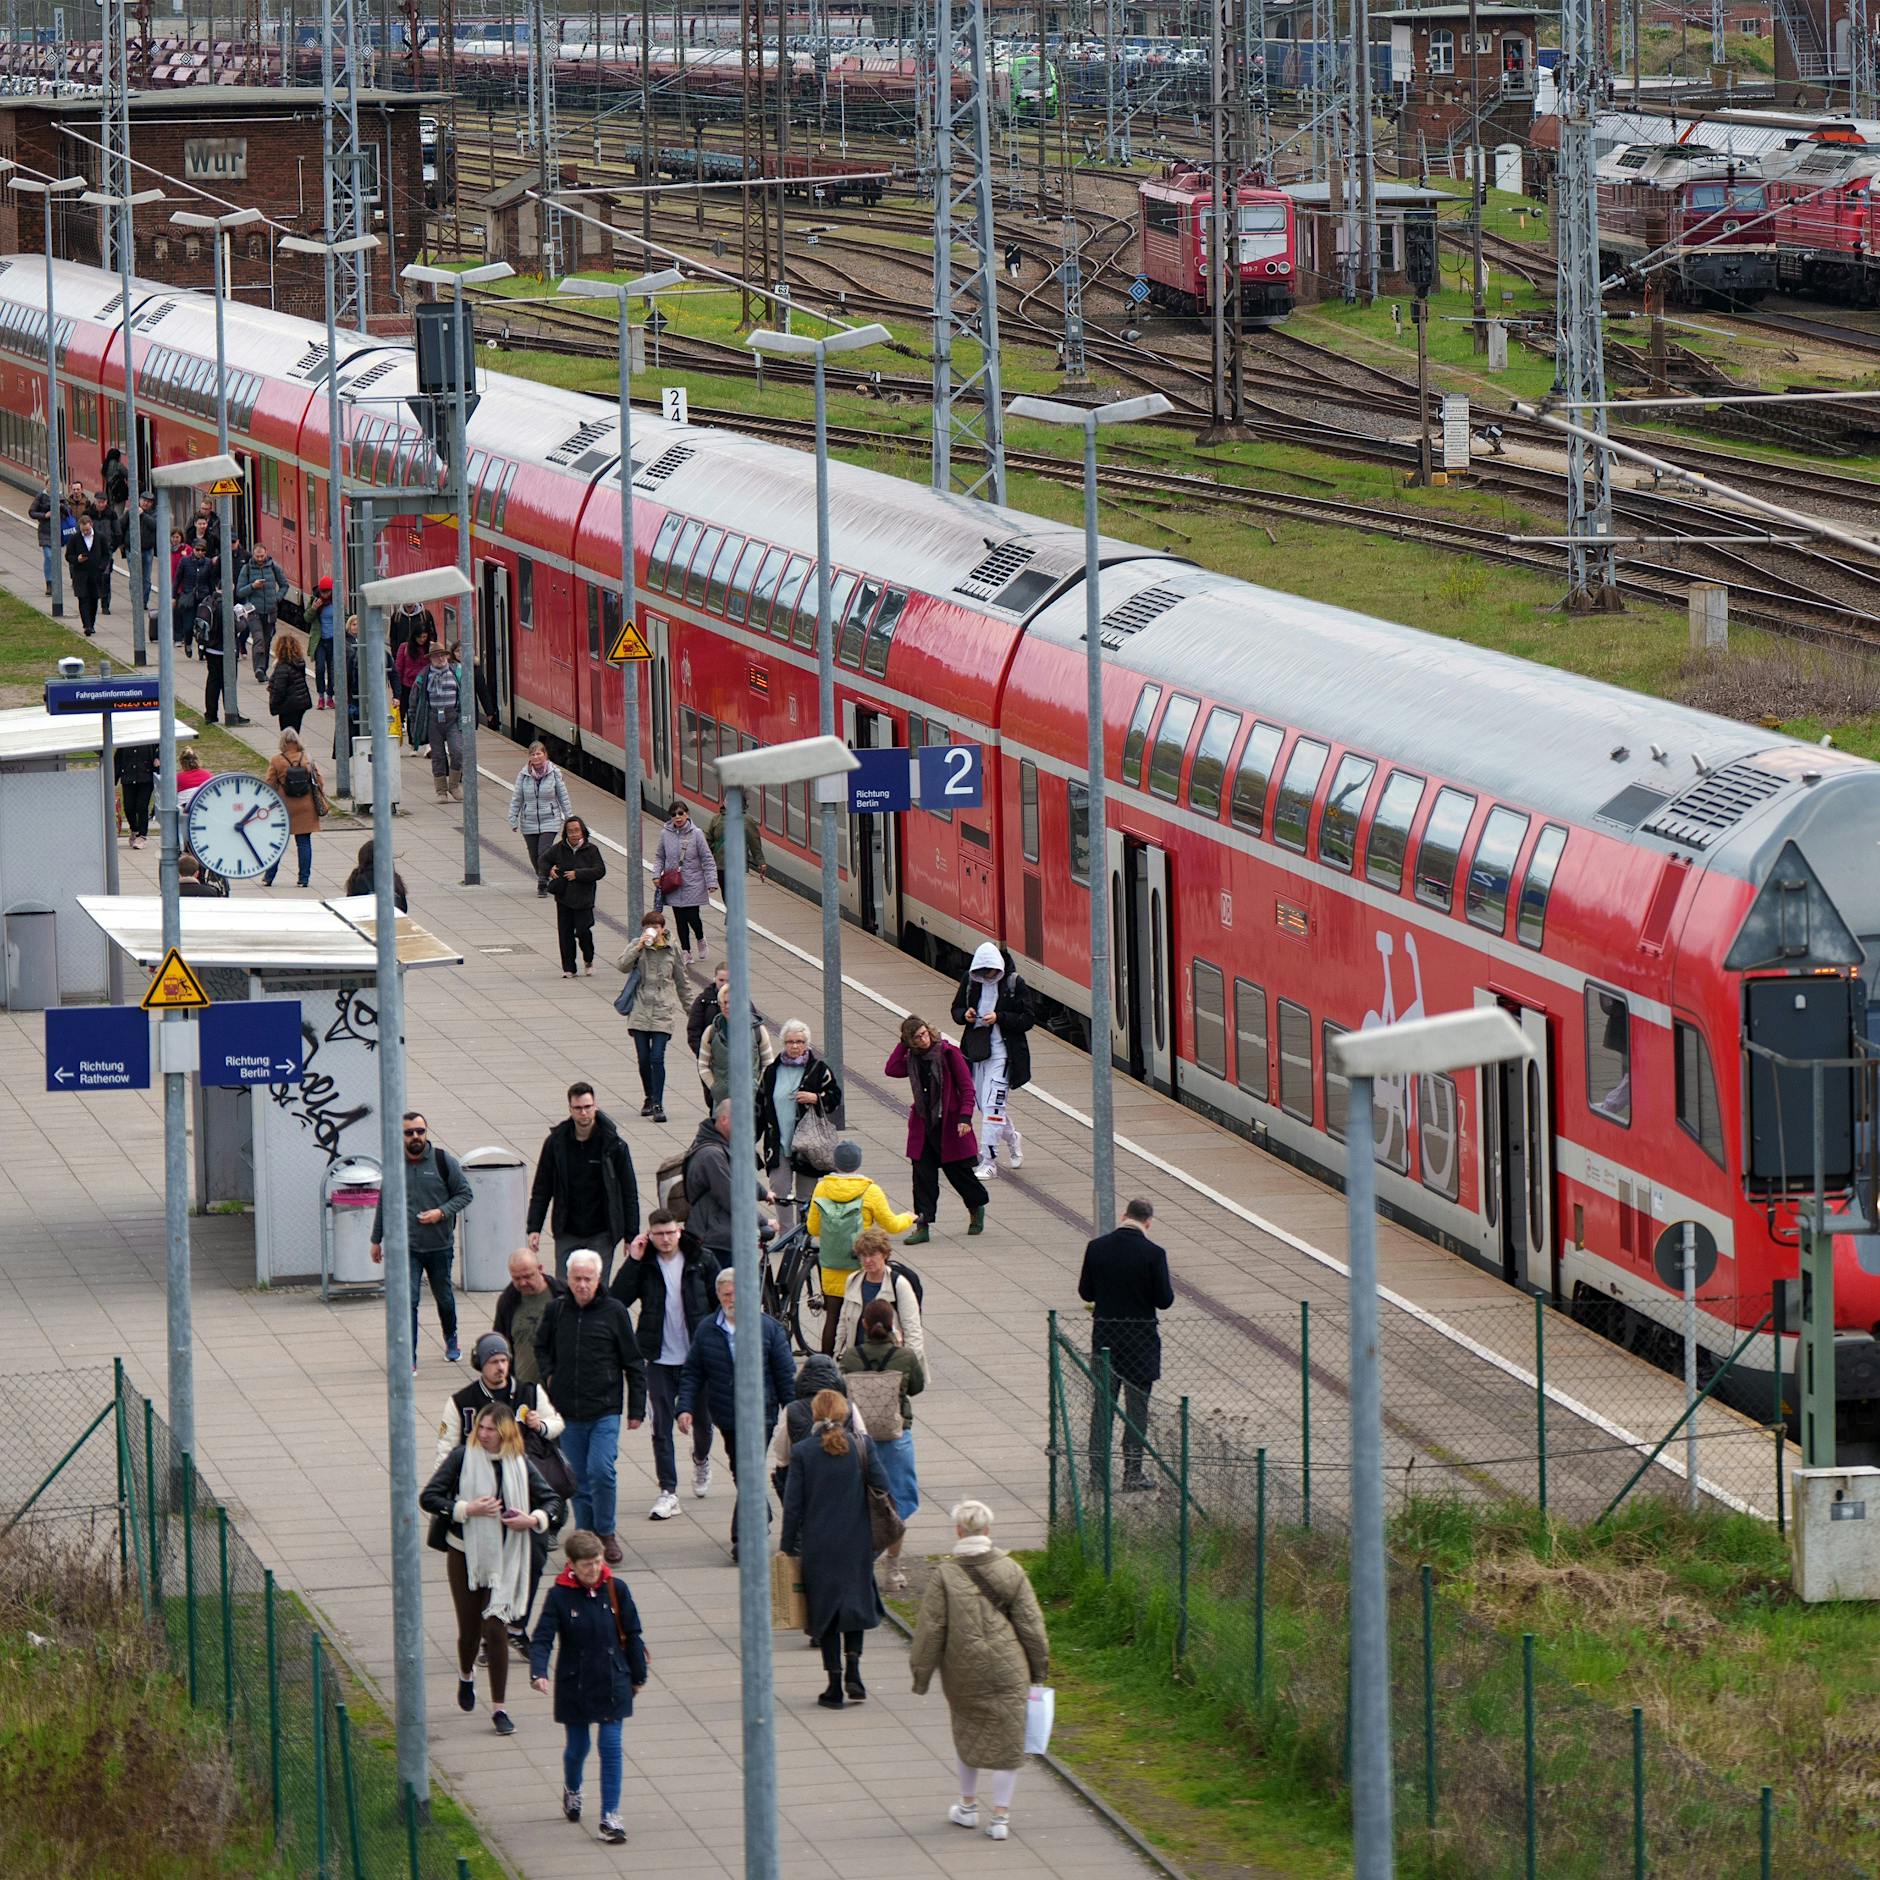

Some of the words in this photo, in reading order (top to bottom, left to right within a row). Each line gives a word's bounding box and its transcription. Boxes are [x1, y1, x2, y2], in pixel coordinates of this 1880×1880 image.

[189, 146, 243, 173] Wur
[670, 390, 679, 406] 2
[671, 408, 681, 421] 4
[75, 690, 142, 699] Fahrgastinformation
[944, 748, 974, 795] 2
[856, 790, 890, 799] Richtung
[856, 800, 879, 808] Berlin
[80, 1061, 124, 1074] Richtung
[225, 1055, 270, 1068] Richtung
[80, 1072, 130, 1084] Rathenow
[240, 1067, 270, 1078] Berlin
[1459, 1099, 1467, 1138] 2
